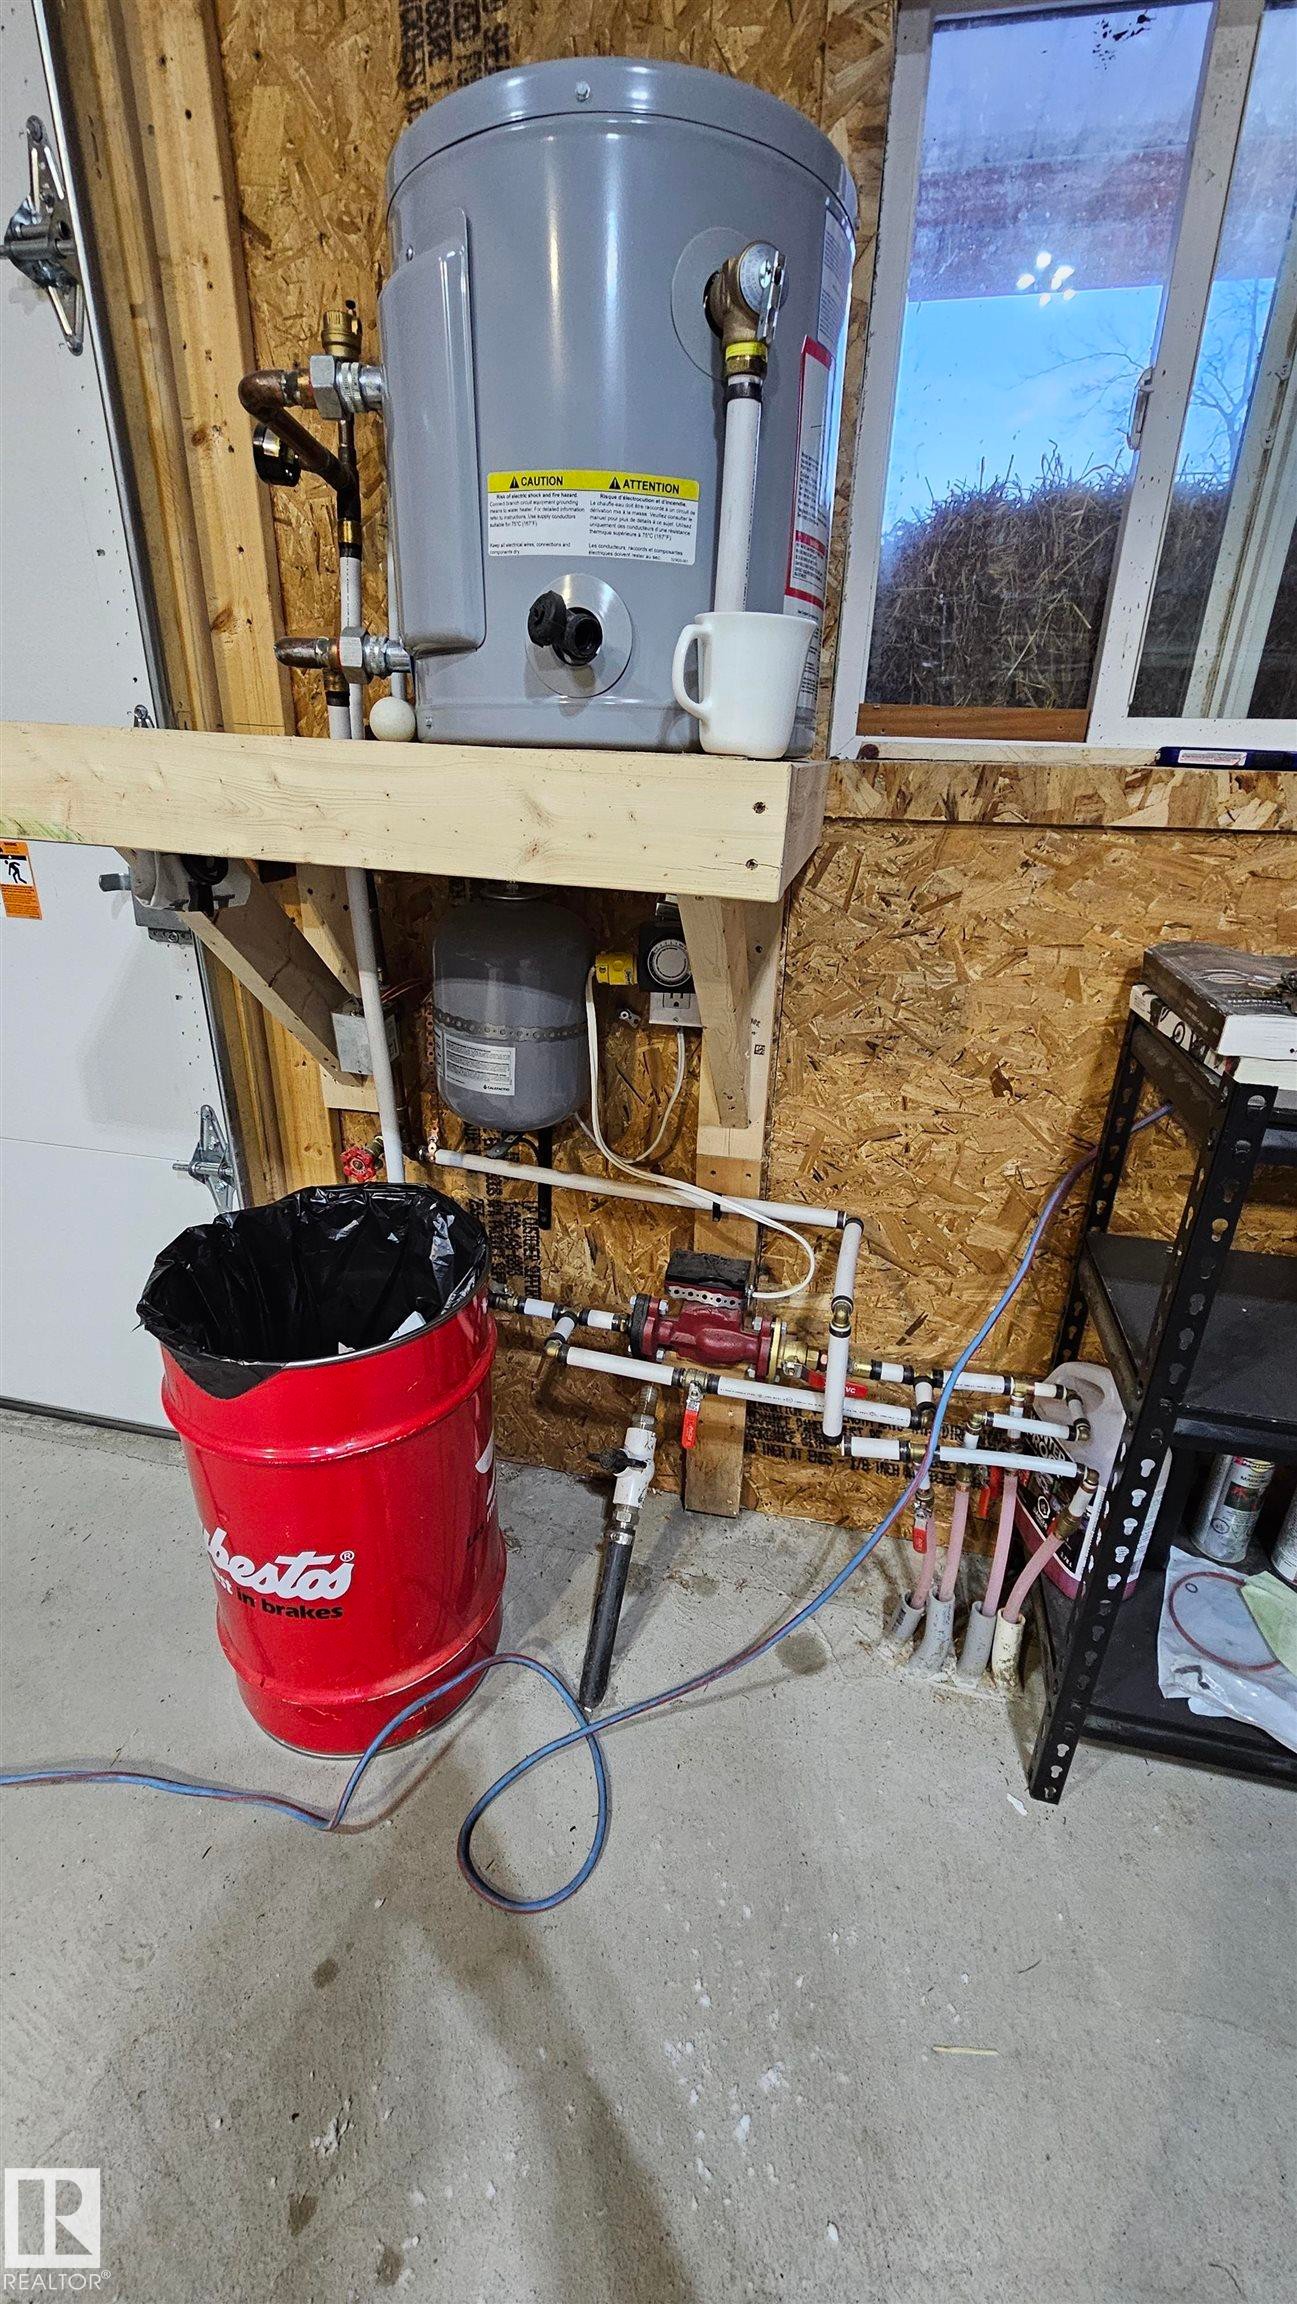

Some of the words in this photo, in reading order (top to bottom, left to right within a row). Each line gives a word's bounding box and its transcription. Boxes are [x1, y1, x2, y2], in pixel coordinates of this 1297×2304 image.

[521, 476, 563, 486] CAUTION
[623, 480, 680, 494] ATTENTION
[203, 1526, 355, 1601] bestos®
[236, 1587, 256, 1608] in
[261, 1599, 344, 1620] brakes
